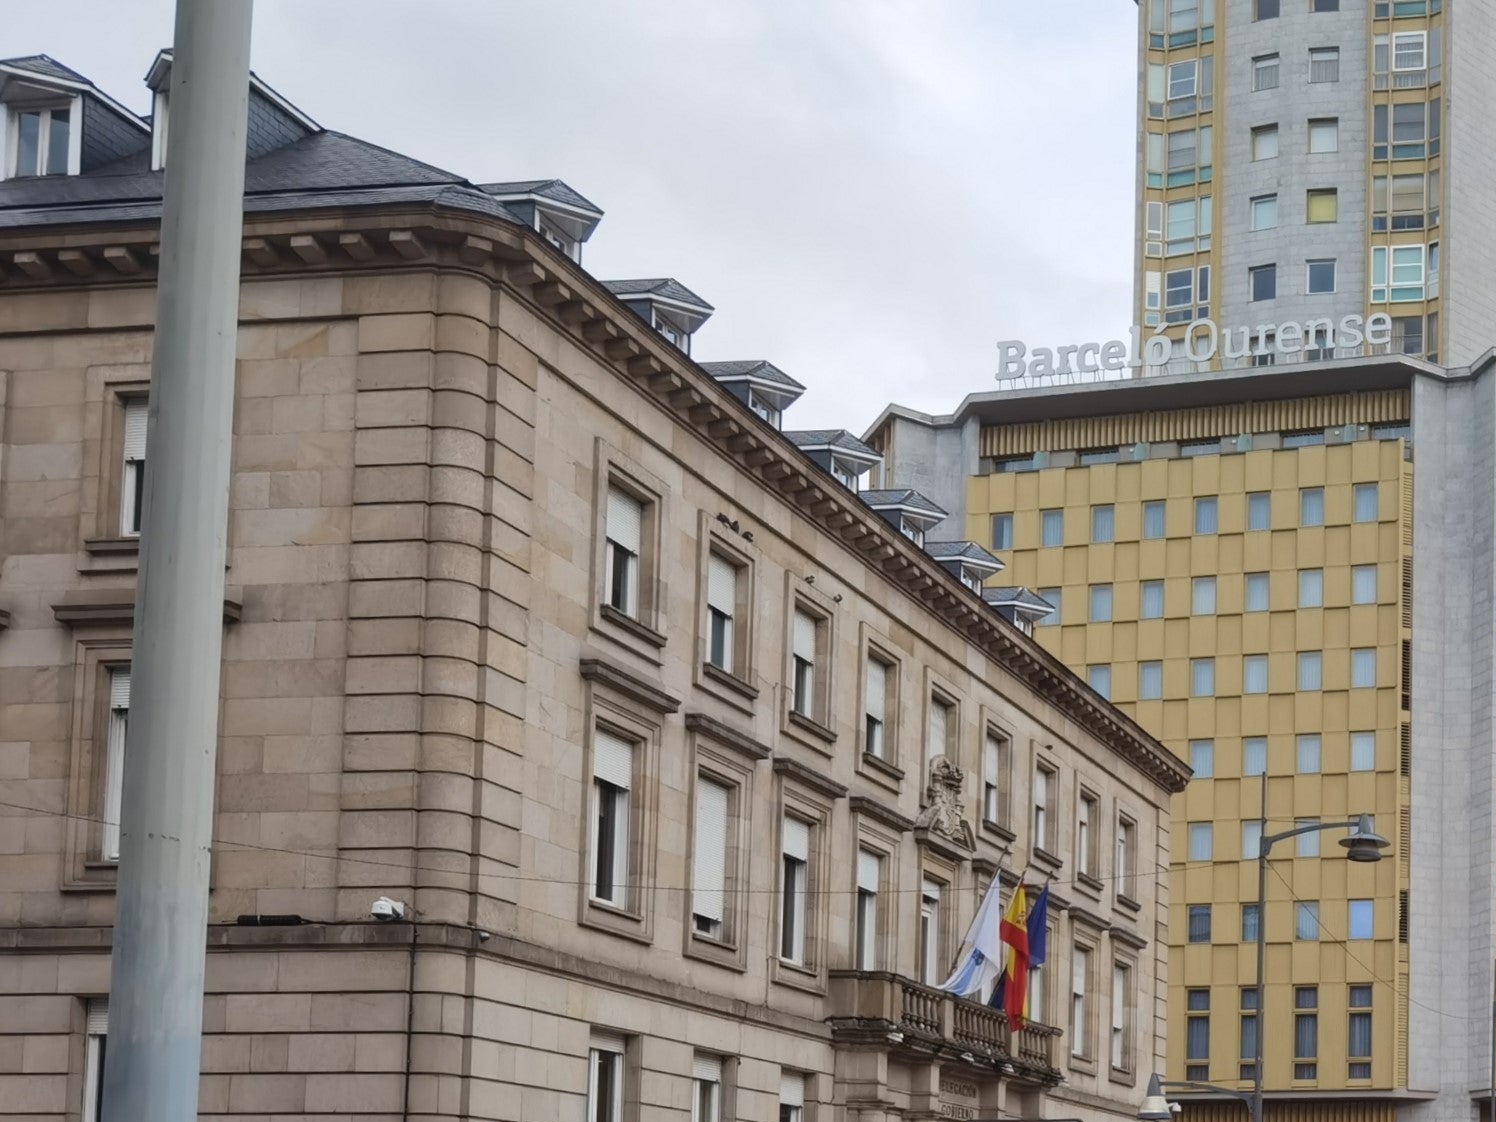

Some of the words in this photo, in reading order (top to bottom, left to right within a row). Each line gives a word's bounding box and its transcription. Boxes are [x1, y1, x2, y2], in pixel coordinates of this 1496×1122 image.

[995, 325, 1172, 380] Barceló
[1185, 312, 1393, 363] Ourense
[941, 1104, 974, 1120] GOBIERNO
